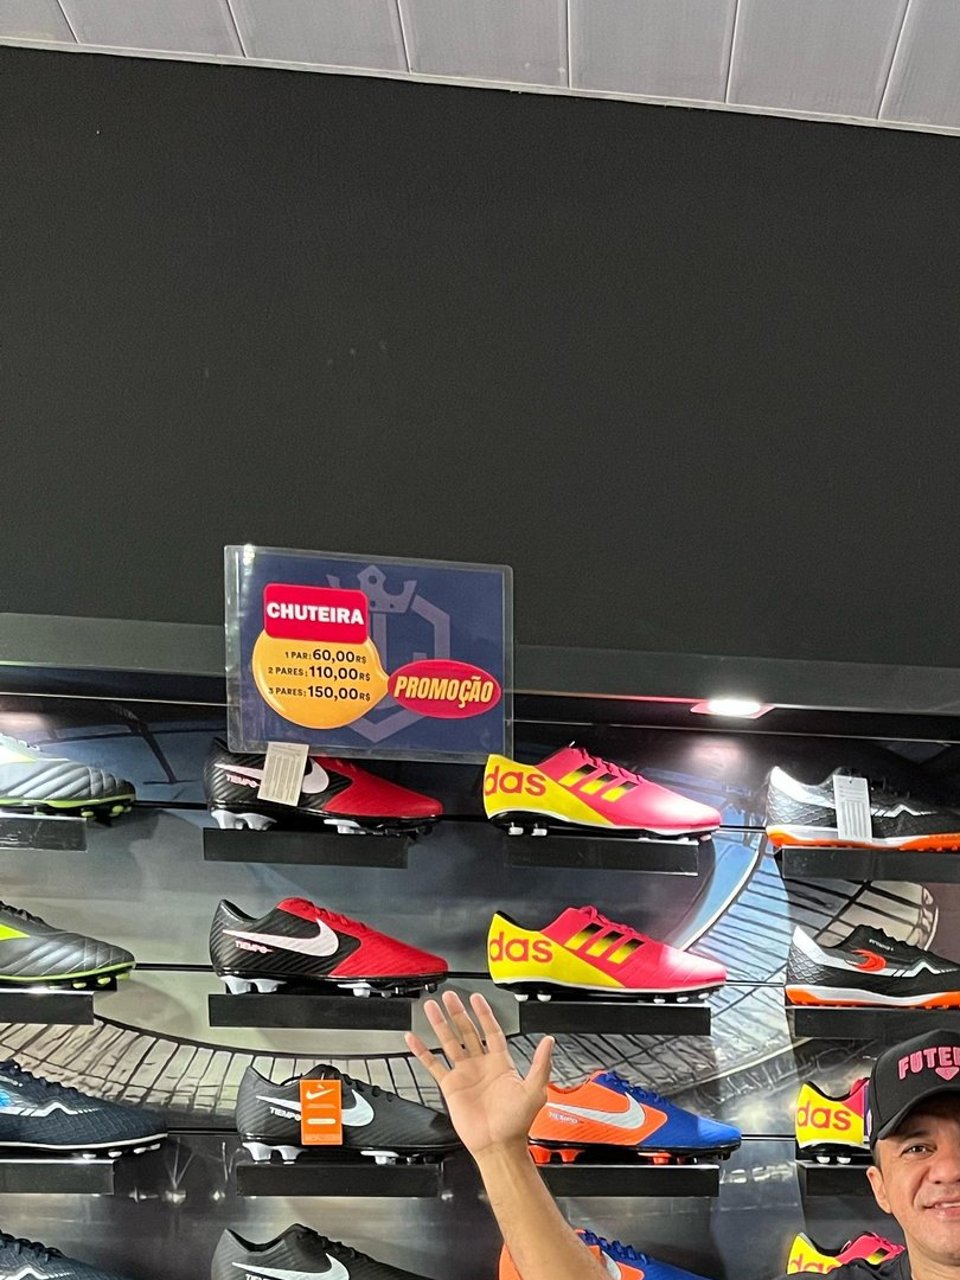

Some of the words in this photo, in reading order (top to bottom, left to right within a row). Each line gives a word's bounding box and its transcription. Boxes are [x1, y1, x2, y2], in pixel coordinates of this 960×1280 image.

[266, 602, 365, 625] CHUTEIRA
[268, 666, 274, 674] 2
[284, 651, 289, 659] 1
[394, 675, 494, 708] PROMOÇÃO
[484, 765, 547, 796] das
[489, 931, 553, 963] das
[797, 1100, 852, 1131] das
